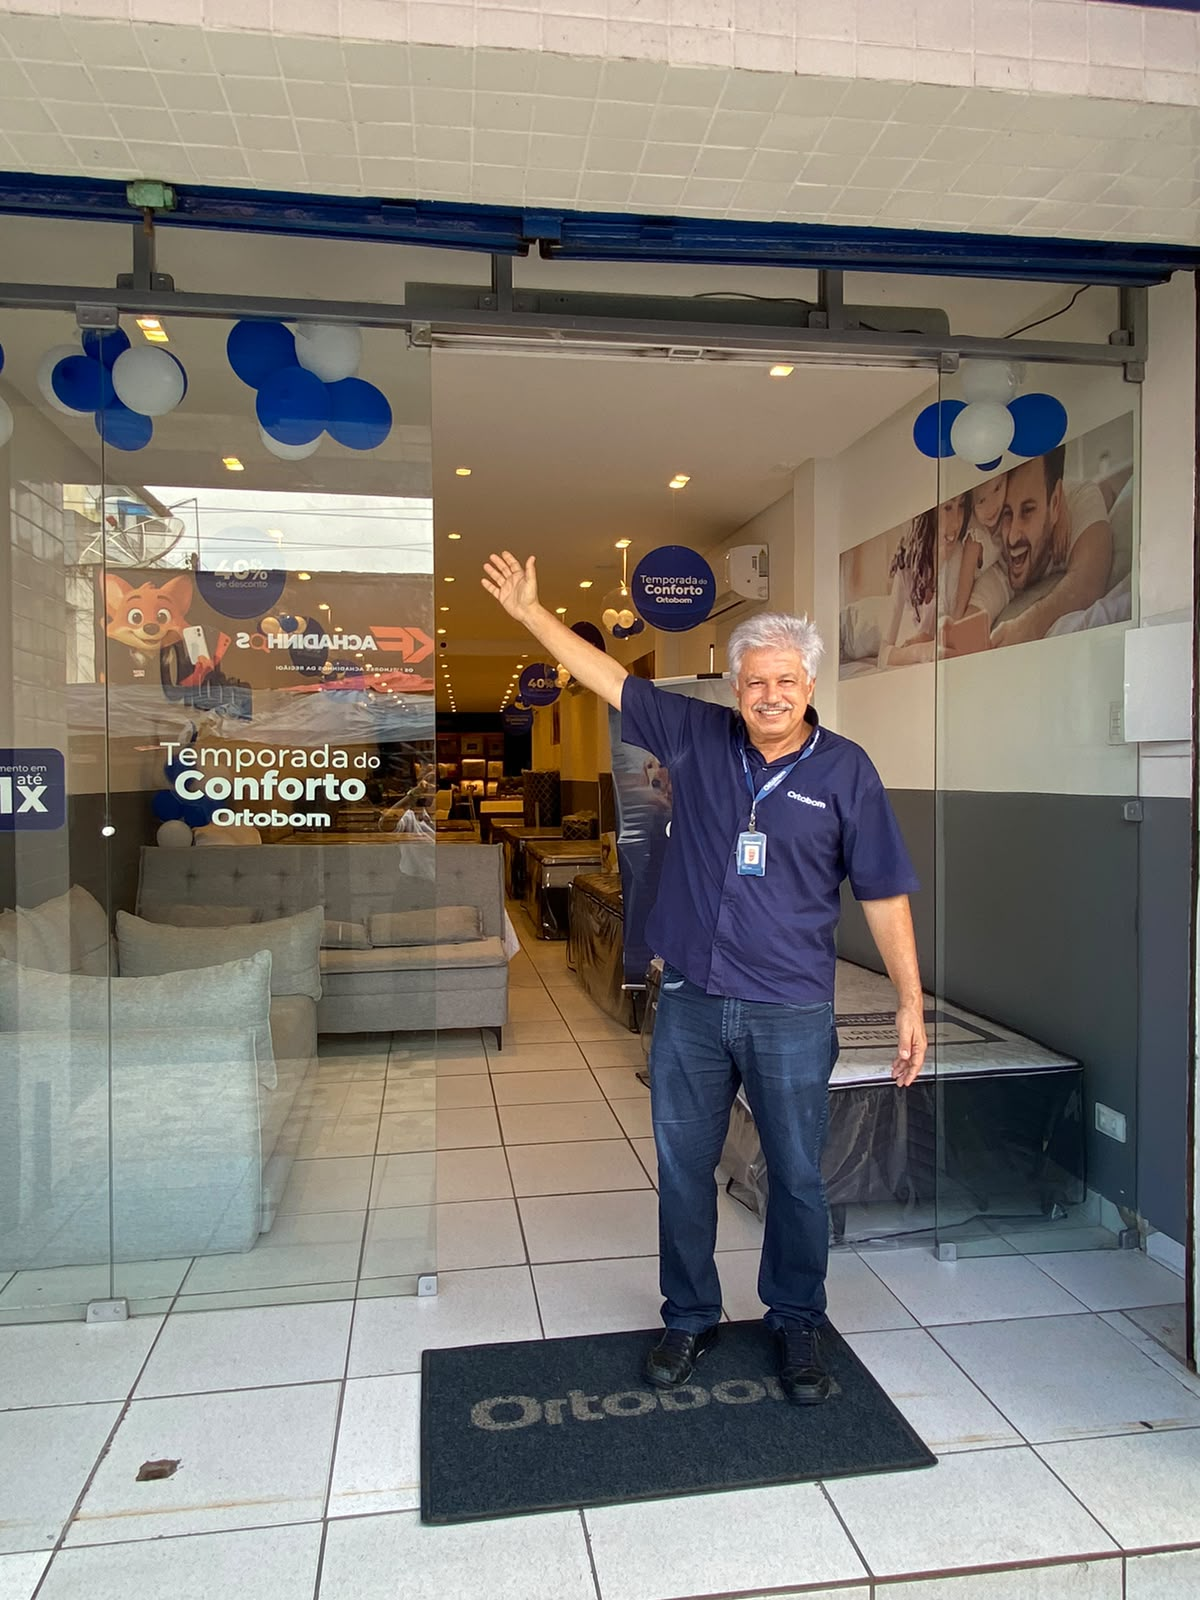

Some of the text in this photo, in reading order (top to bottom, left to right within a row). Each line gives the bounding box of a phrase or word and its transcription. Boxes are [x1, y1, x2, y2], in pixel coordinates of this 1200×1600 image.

[214, 560, 268, 580] 40%
[640, 575, 697, 585] Temporada
[644, 584, 703, 596] Conforto
[655, 596, 693, 604] Ortobom
[159, 742, 381, 772] Temporada do
[17, 773, 43, 785] até
[174, 769, 367, 801] Conforto
[787, 790, 826, 809] Ortobom
[211, 808, 331, 827] Ortobom
